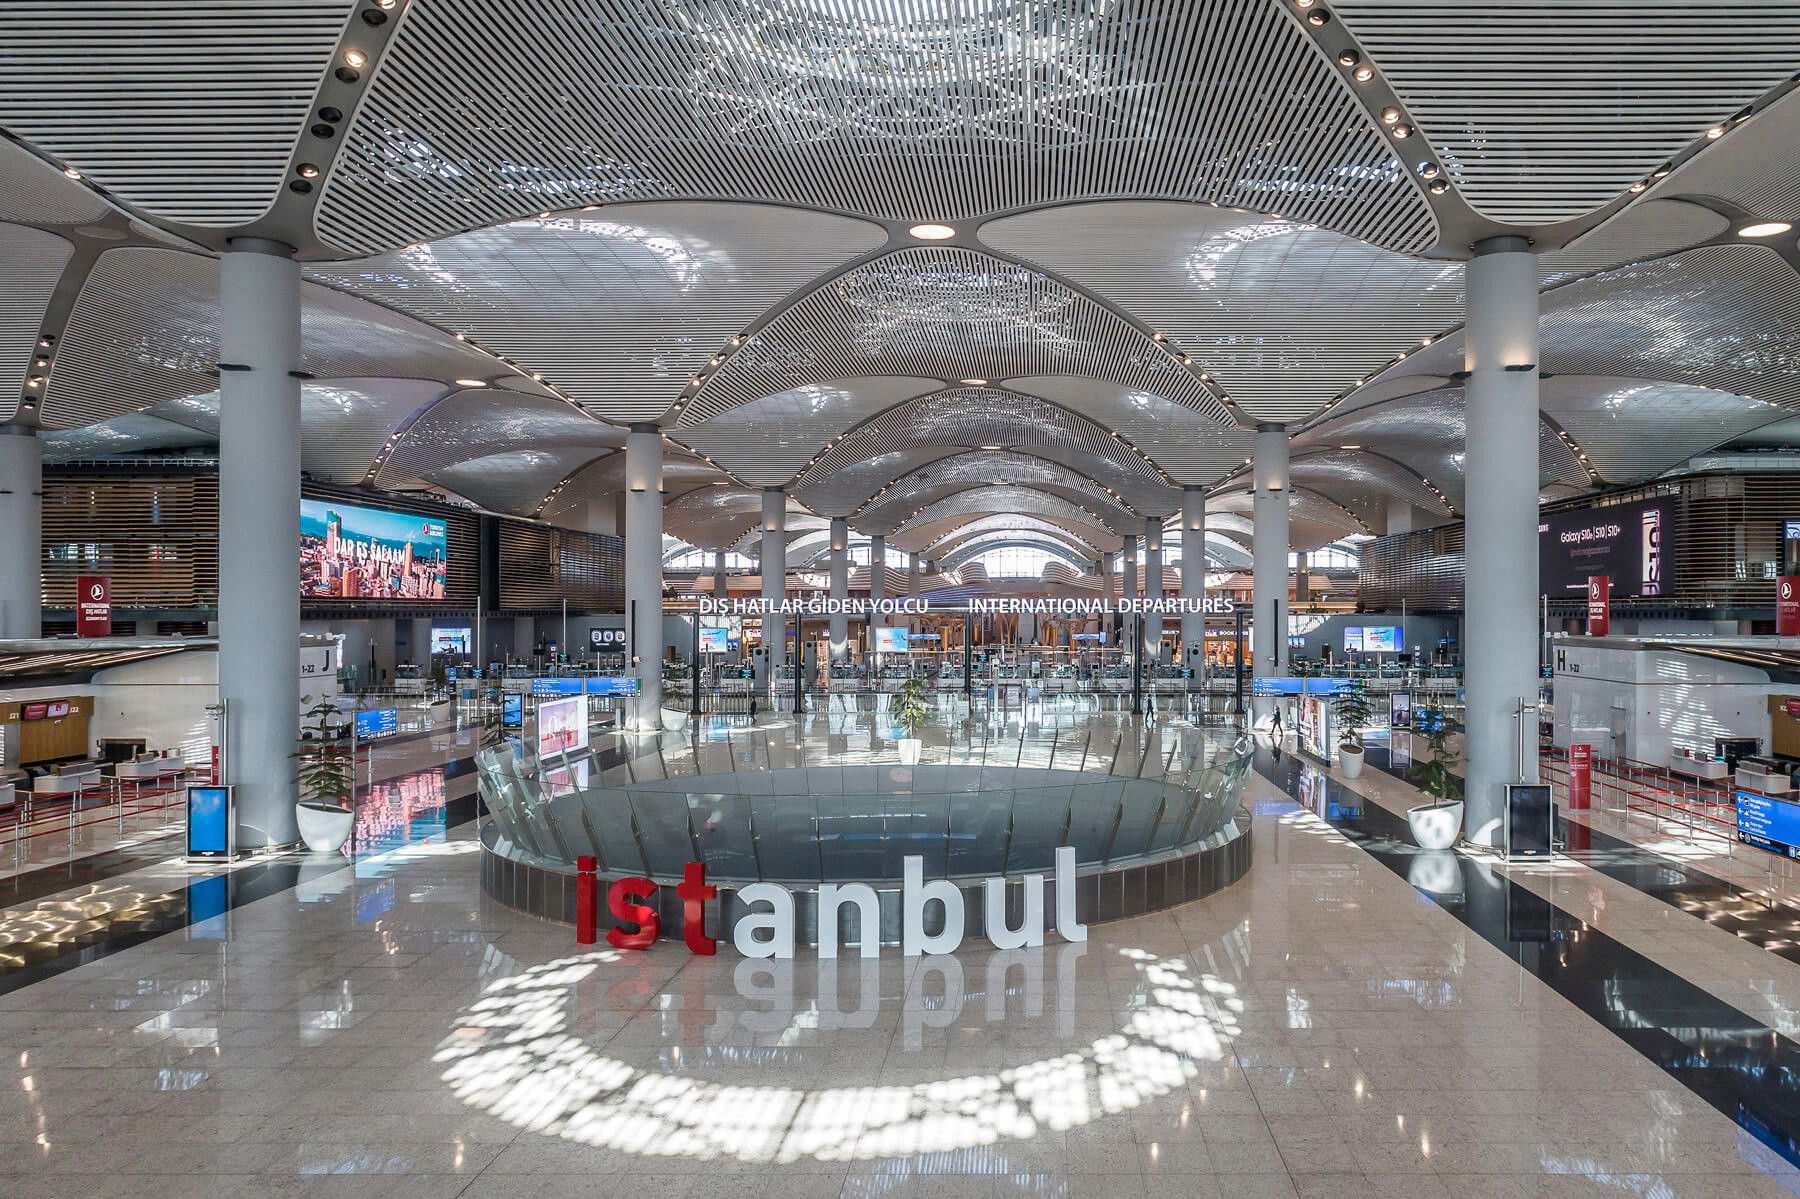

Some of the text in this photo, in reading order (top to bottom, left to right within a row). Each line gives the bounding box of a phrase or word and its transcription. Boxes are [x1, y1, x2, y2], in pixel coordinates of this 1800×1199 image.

[1561, 531, 1580, 543] Galaxy
[1595, 526, 1605, 538] S10
[1607, 524, 1620, 537] S10+
[334, 537, 405, 565] DAR ES SALAAM
[699, 595, 1234, 617] DIŞ HATLAR GİDEN YOLCU INTERNATIONAL DEPARTURES
[322, 649, 330, 672] J
[1557, 649, 1566, 671] H
[576, 846, 1088, 959] istanbul
